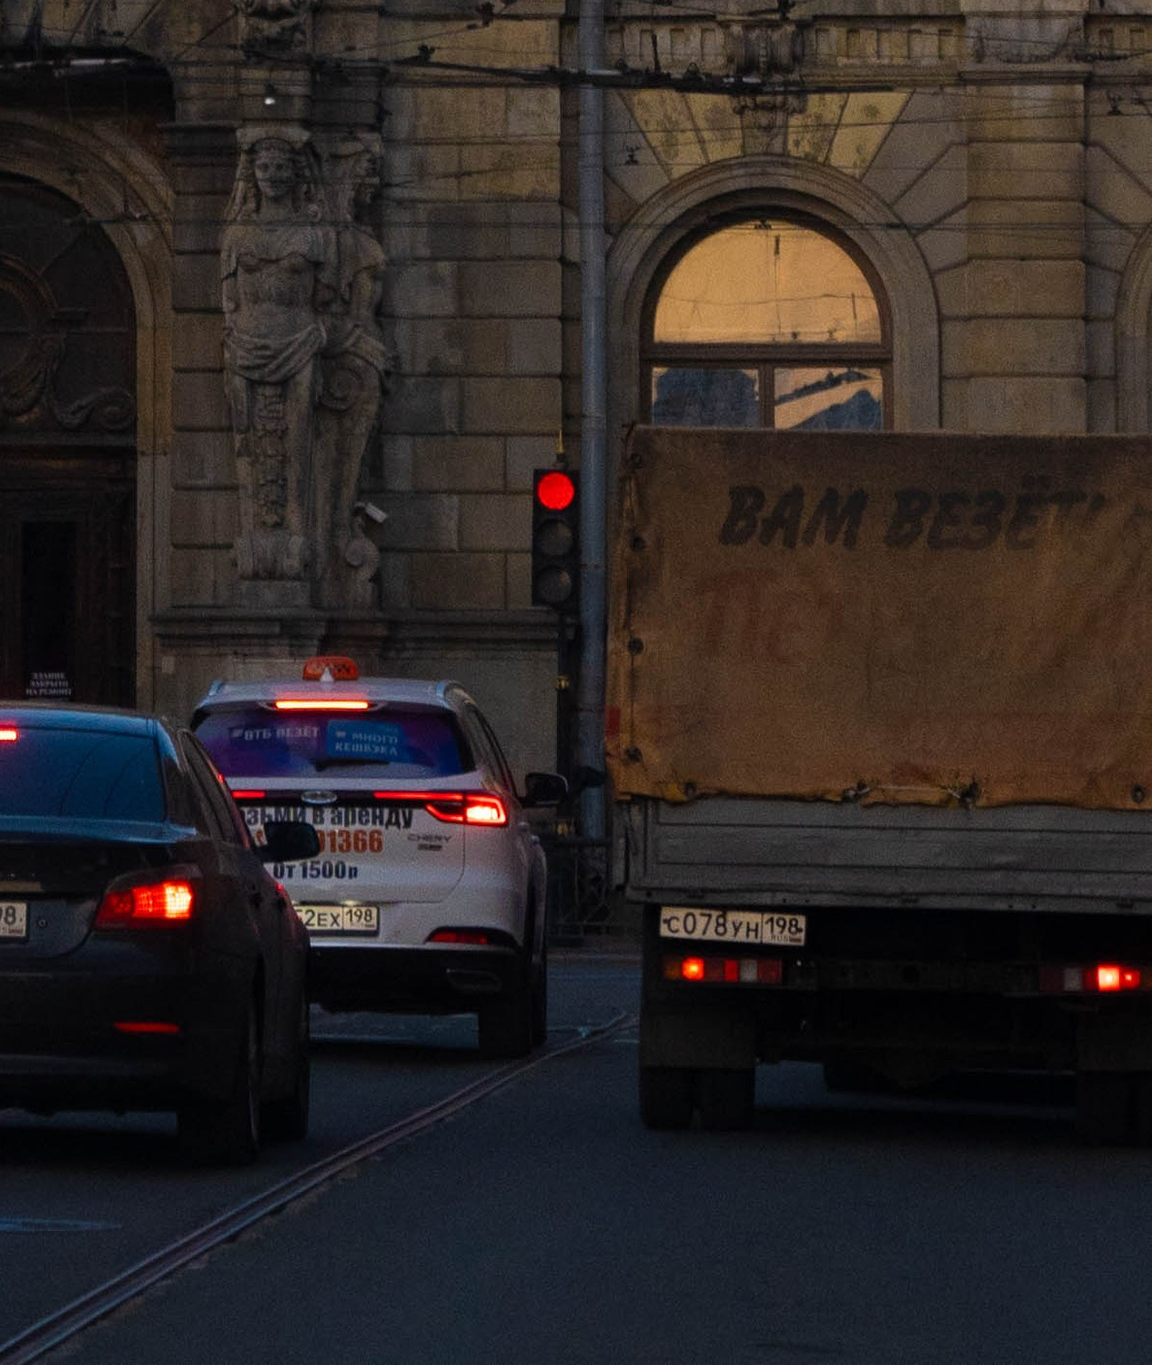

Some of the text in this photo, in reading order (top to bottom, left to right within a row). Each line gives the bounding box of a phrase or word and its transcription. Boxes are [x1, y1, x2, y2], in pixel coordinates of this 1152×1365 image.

[718, 483, 869, 550] ВАМ
[330, 806, 413, 829] аренду
[345, 909, 373, 923] 198
[667, 911, 800, 940] С078УН 198
